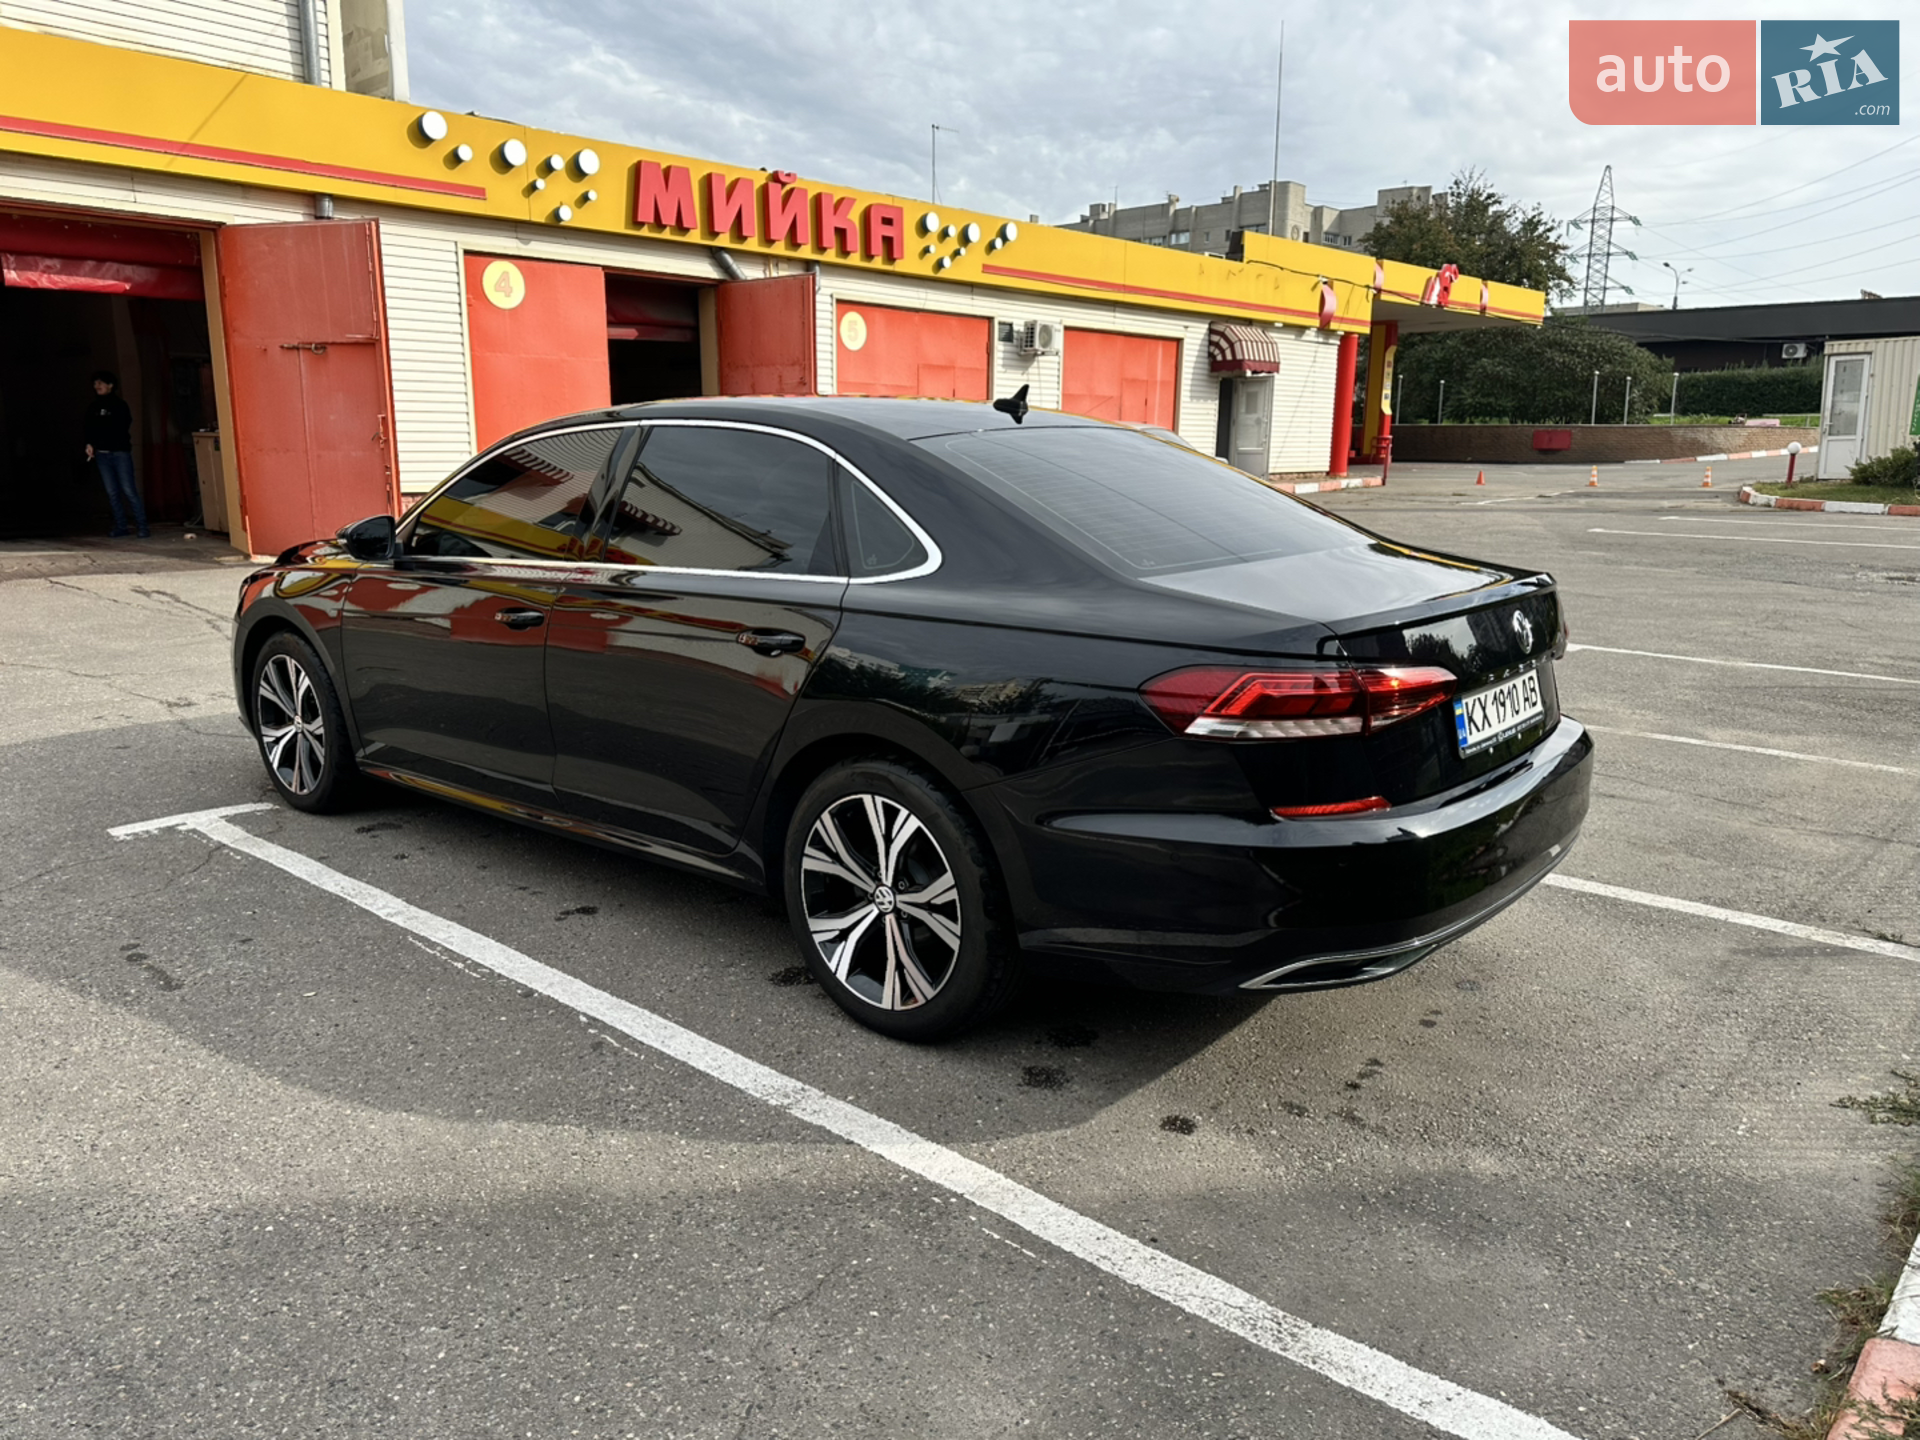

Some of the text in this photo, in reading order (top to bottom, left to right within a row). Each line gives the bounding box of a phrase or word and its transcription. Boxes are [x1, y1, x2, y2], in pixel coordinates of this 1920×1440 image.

[634, 159, 904, 260] МИЙКА
[494, 270, 513, 298] 4
[847, 319, 859, 342] 5
[1491, 683, 1520, 724] 1910
[1522, 675, 1538, 711] AB
